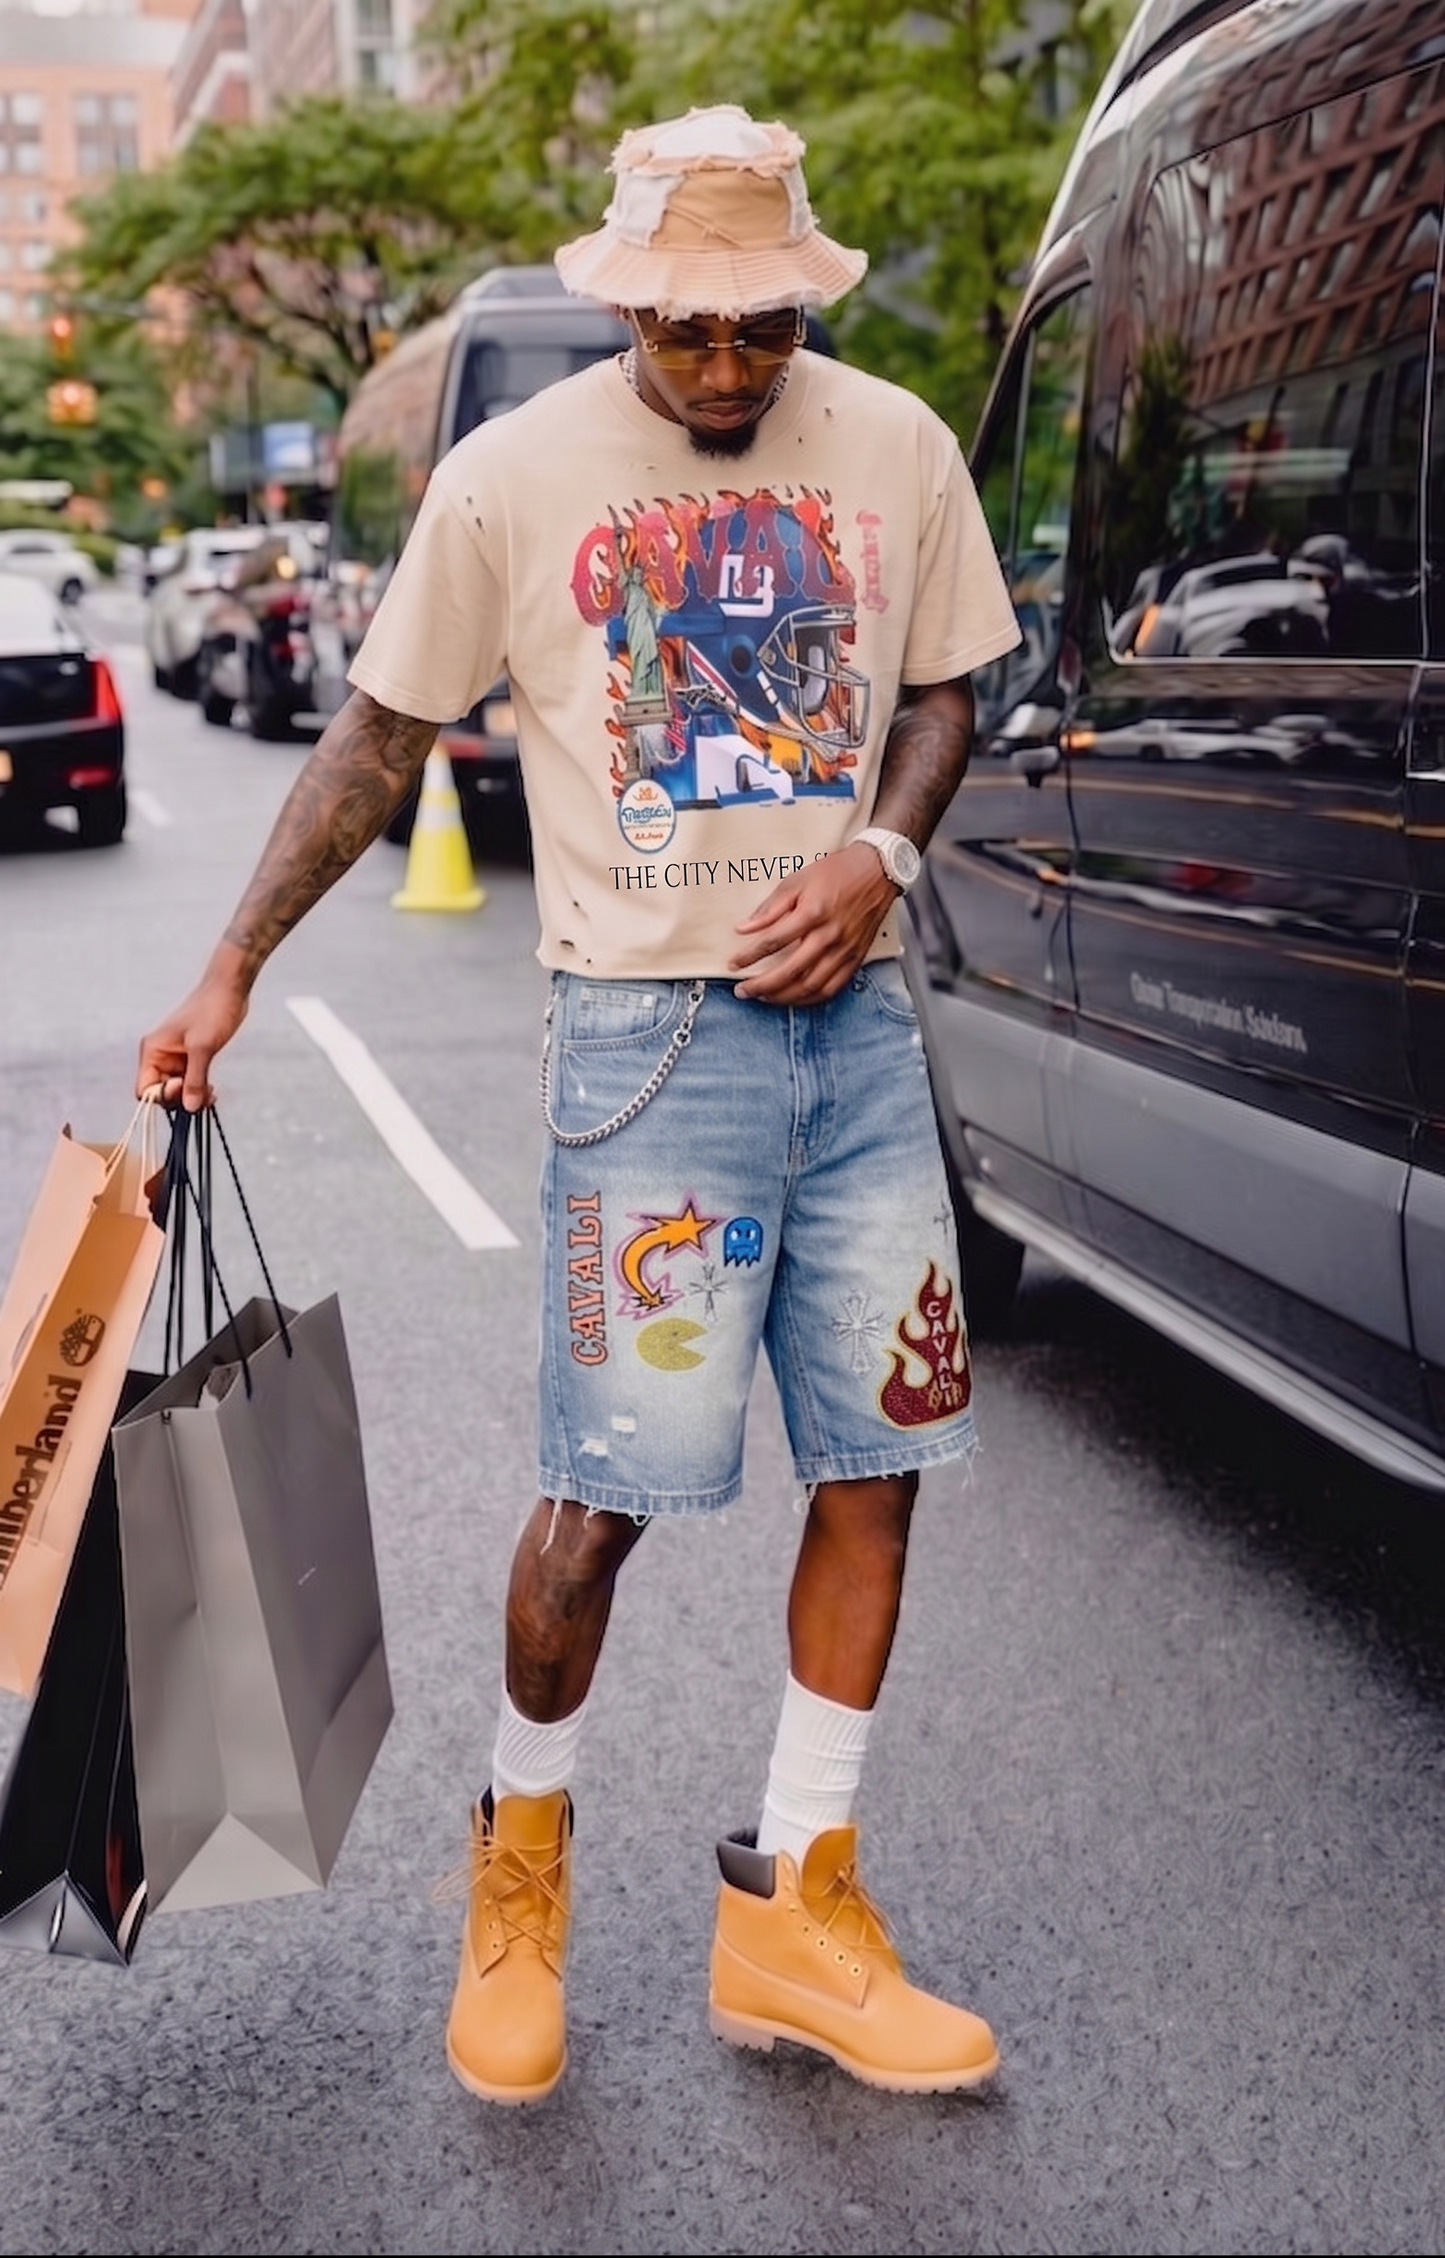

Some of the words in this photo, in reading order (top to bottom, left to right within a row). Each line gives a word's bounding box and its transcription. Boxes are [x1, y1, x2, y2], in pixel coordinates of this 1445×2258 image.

[608, 865, 658, 890] THE
[664, 860, 720, 888] CITY
[727, 854, 805, 884] NEVER
[567, 1191, 609, 1367] CAVALI
[926, 1300, 953, 1407] CAVALI
